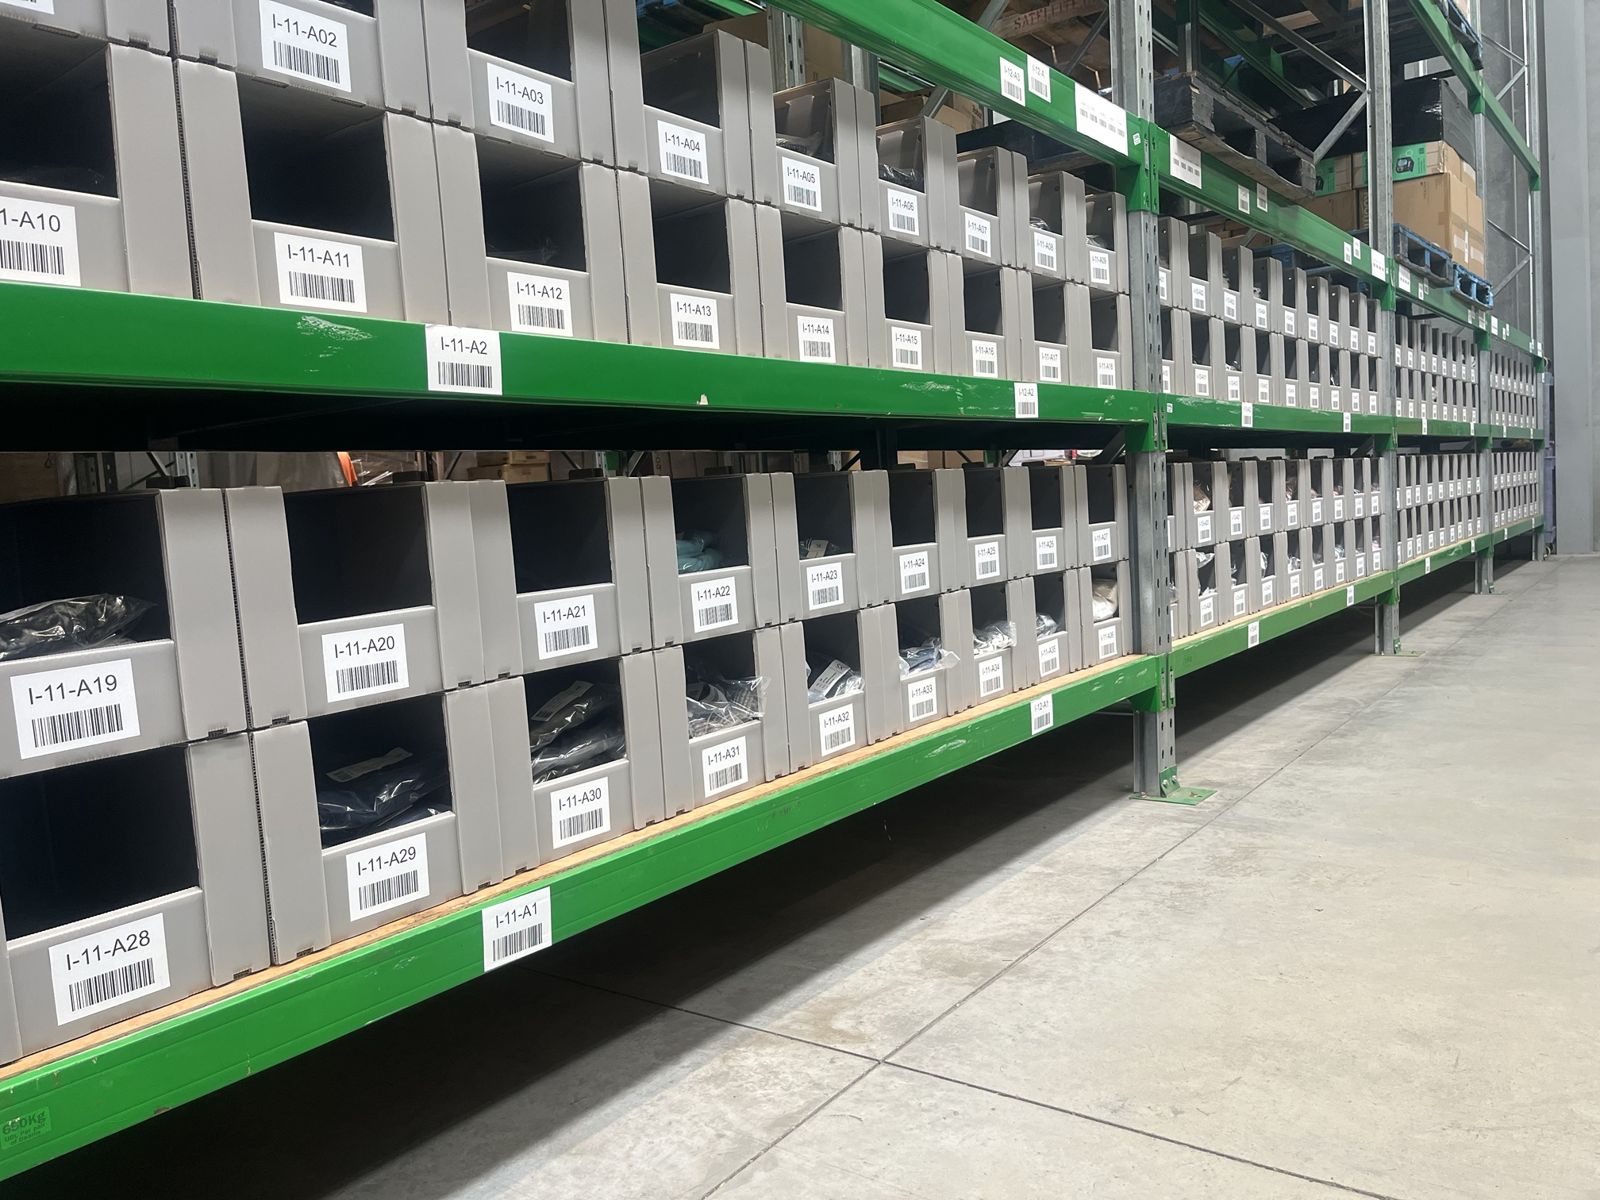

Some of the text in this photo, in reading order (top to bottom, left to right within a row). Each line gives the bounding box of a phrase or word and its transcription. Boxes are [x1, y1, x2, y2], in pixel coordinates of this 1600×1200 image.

[272, 13, 338, 48] I-11-A02
[496, 76, 545, 104] I-11-A03
[664, 132, 700, 152] I-11-A04
[786, 166, 816, 184] I-11-A05
[891, 197, 914, 212] I-11-A06
[967, 220, 988, 234] I-11-A07
[287, 244, 351, 268] I-11-A11
[516, 280, 562, 300] I-11-A12
[677, 302, 712, 317] I-11-A13
[802, 322, 830, 336] I-11-A14
[895, 332, 918, 344] I-11-A15
[441, 337, 488, 356] I-11-A2
[903, 558, 925, 570] I-11-A24
[811, 570, 838, 583] I-11-A23
[696, 585, 731, 601] I-11-A22
[542, 605, 587, 623] I-11-A21
[333, 635, 396, 658] I-11-A20
[982, 663, 1000, 675] I-11-A34
[28, 674, 118, 705] I-11-A19
[911, 684, 933, 698] I-11-A33
[824, 712, 850, 728] I-11-A32
[707, 745, 740, 765] I-11-A31
[558, 788, 602, 810] I-11-A30
[356, 846, 417, 876] I-11-A29
[494, 902, 539, 927] I-11-A1
[64, 930, 152, 969] I-11-A28
